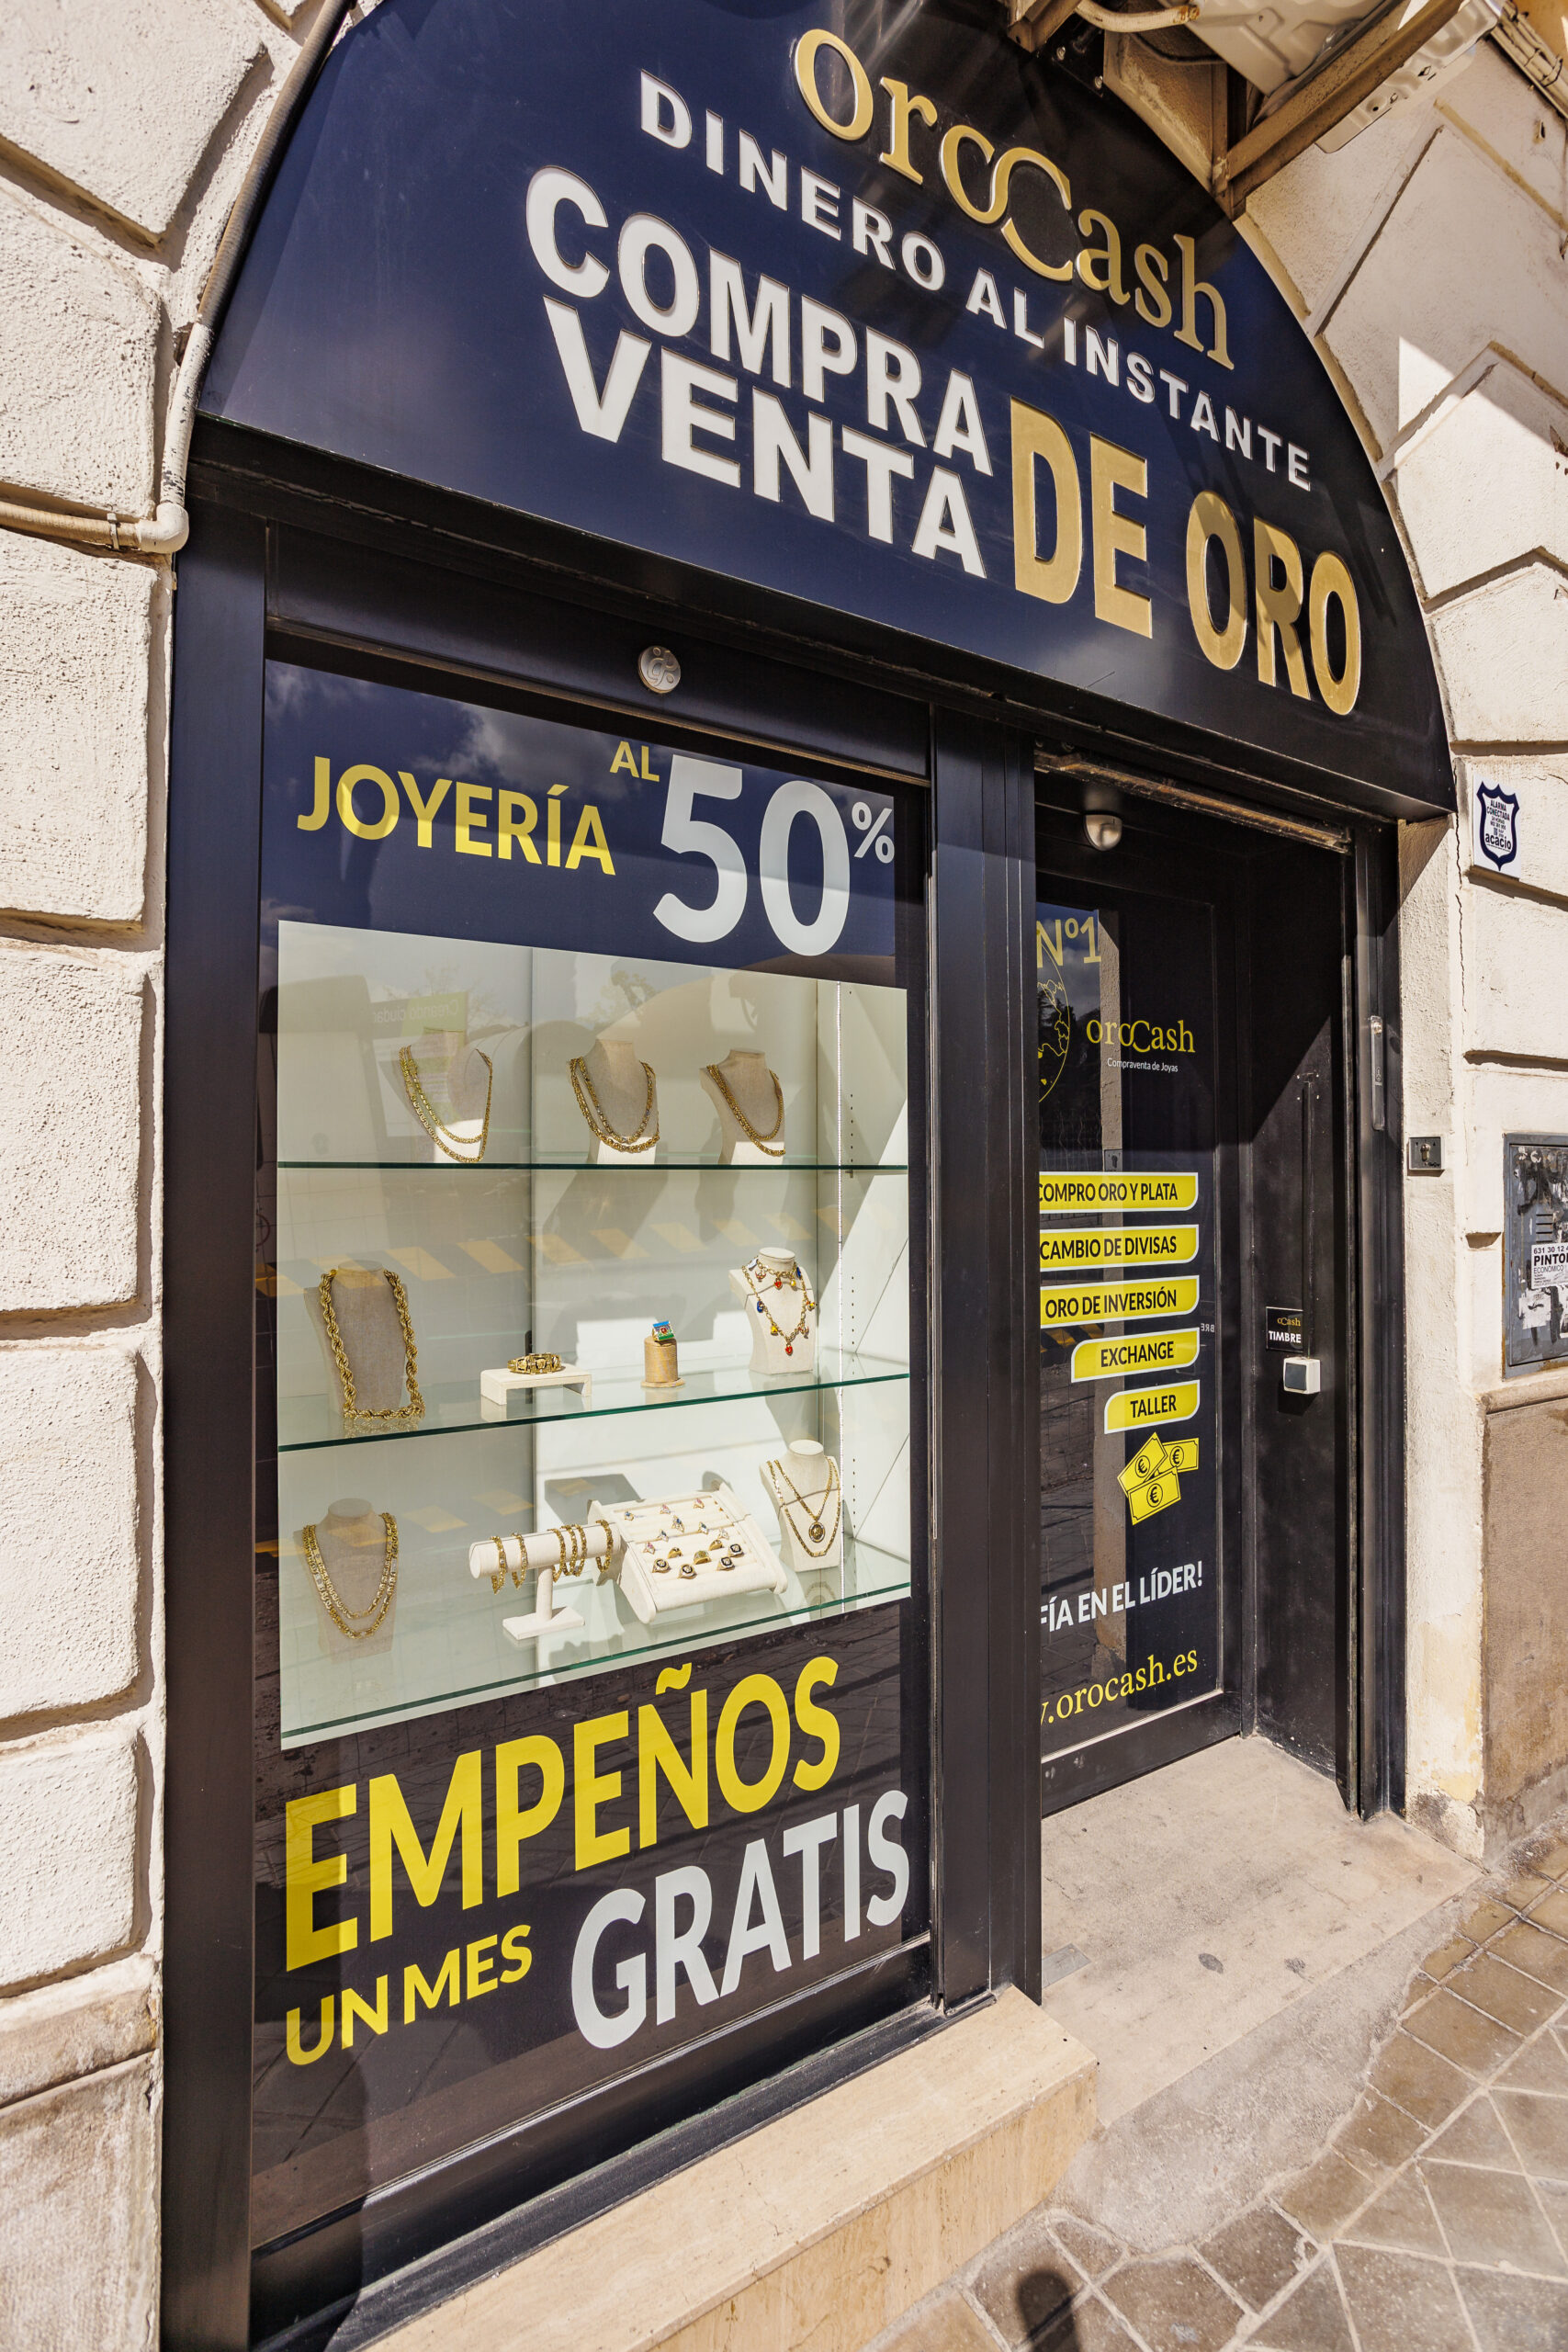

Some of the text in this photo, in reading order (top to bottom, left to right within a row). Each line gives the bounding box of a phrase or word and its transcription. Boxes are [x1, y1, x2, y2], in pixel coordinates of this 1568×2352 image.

[640, 69, 1312, 492] DINERO AL INSTANTE
[525, 164, 993, 477] COMPRA
[543, 296, 987, 579] VENTA
[1010, 397, 1361, 716] DE ORO
[297, 756, 616, 876] JOYERÍA
[610, 741, 660, 783] AL
[1485, 833, 1511, 849] acacio
[1107, 1057, 1179, 1073] Compraventa de Joyas
[1099, 1182, 1128, 1202] ORO
[1130, 1182, 1138, 1201] Y
[1140, 1182, 1178, 1201] PLATA
[1040, 1236, 1177, 1260] CAMBIO DE DIVISAS
[1534, 1252, 1568, 1266] PINTO
[1045, 1288, 1177, 1318] ORO DE INVERSIÓN
[1100, 1341, 1174, 1368] EXCHANGE
[1269, 1330, 1301, 1343] TIMBRE
[1131, 1395, 1177, 1418] TALLER
[1078, 1588, 1107, 1623] EN
[1112, 1581, 1135, 1612] EL
[1140, 1560, 1202, 1604] LÍDER!
[286, 1656, 841, 1973] EMPEÑOS
[571, 1790, 909, 2050] GRATIS
[287, 1925, 533, 2066] UN MES
